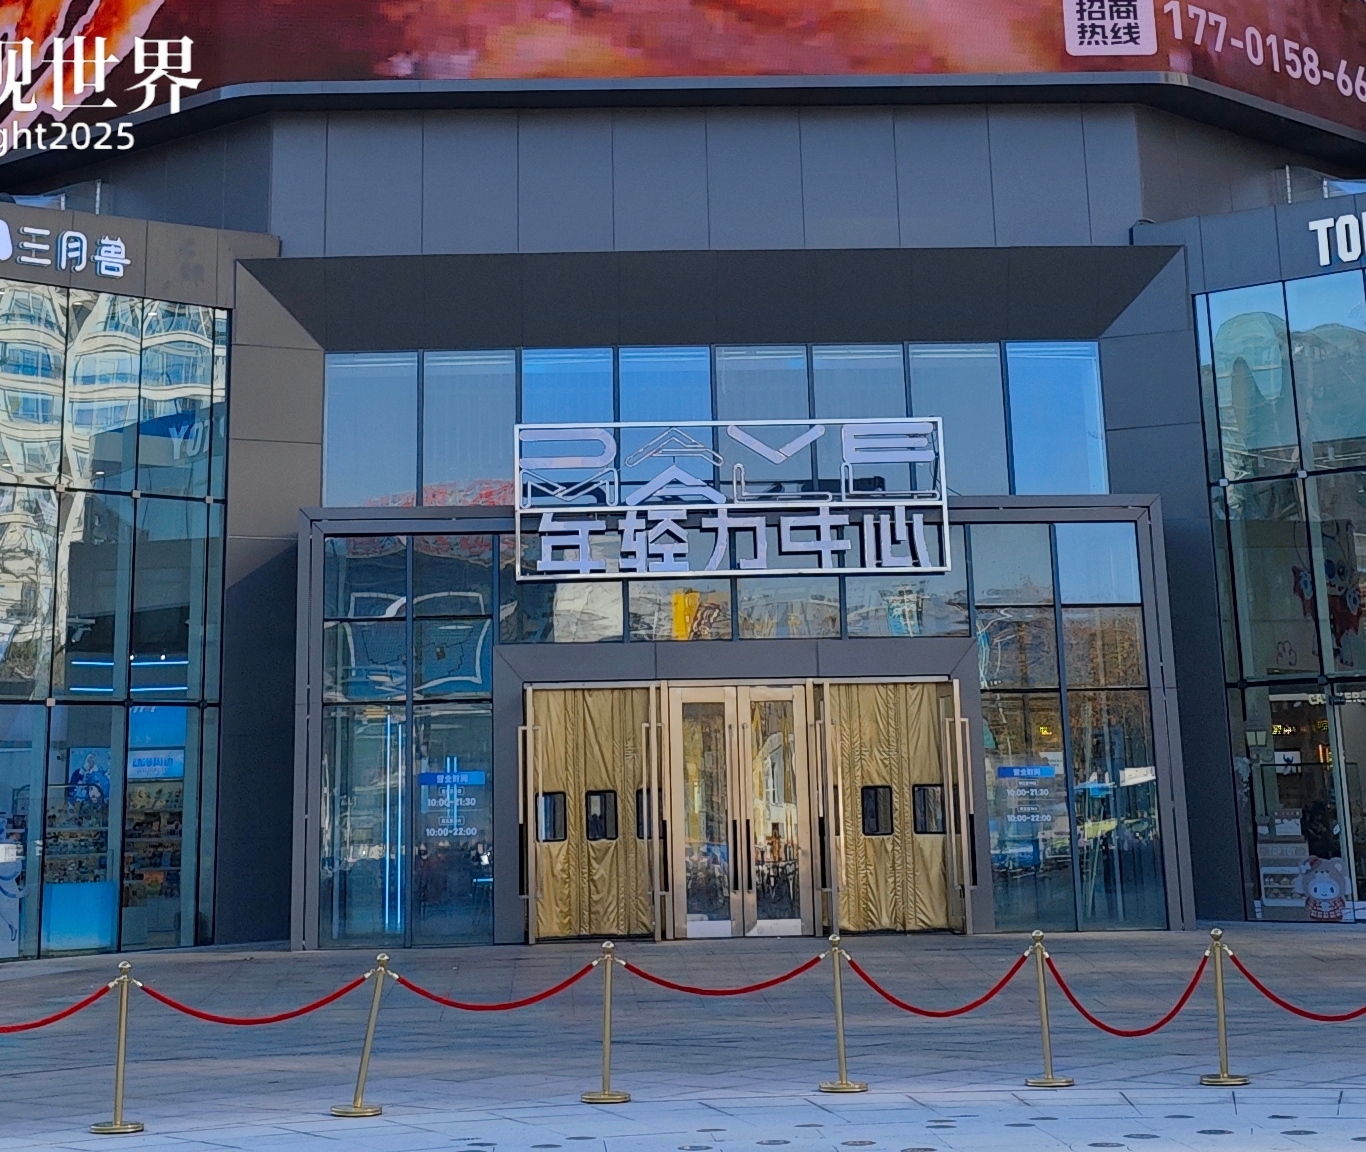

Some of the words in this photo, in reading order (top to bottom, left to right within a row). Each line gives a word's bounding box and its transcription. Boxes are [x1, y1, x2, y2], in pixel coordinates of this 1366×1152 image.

[1076, 22, 1141, 46] 热线
[18, 226, 131, 279] 三月兽
[518, 423, 936, 470] DAVE
[536, 506, 934, 573] 年轻力中心
[436, 774, 469, 784] 营业时间
[1013, 768, 1041, 776] 营业时间
[1007, 814, 1052, 823] 10:00-22:00
[426, 827, 478, 837] 10:00-22:00
